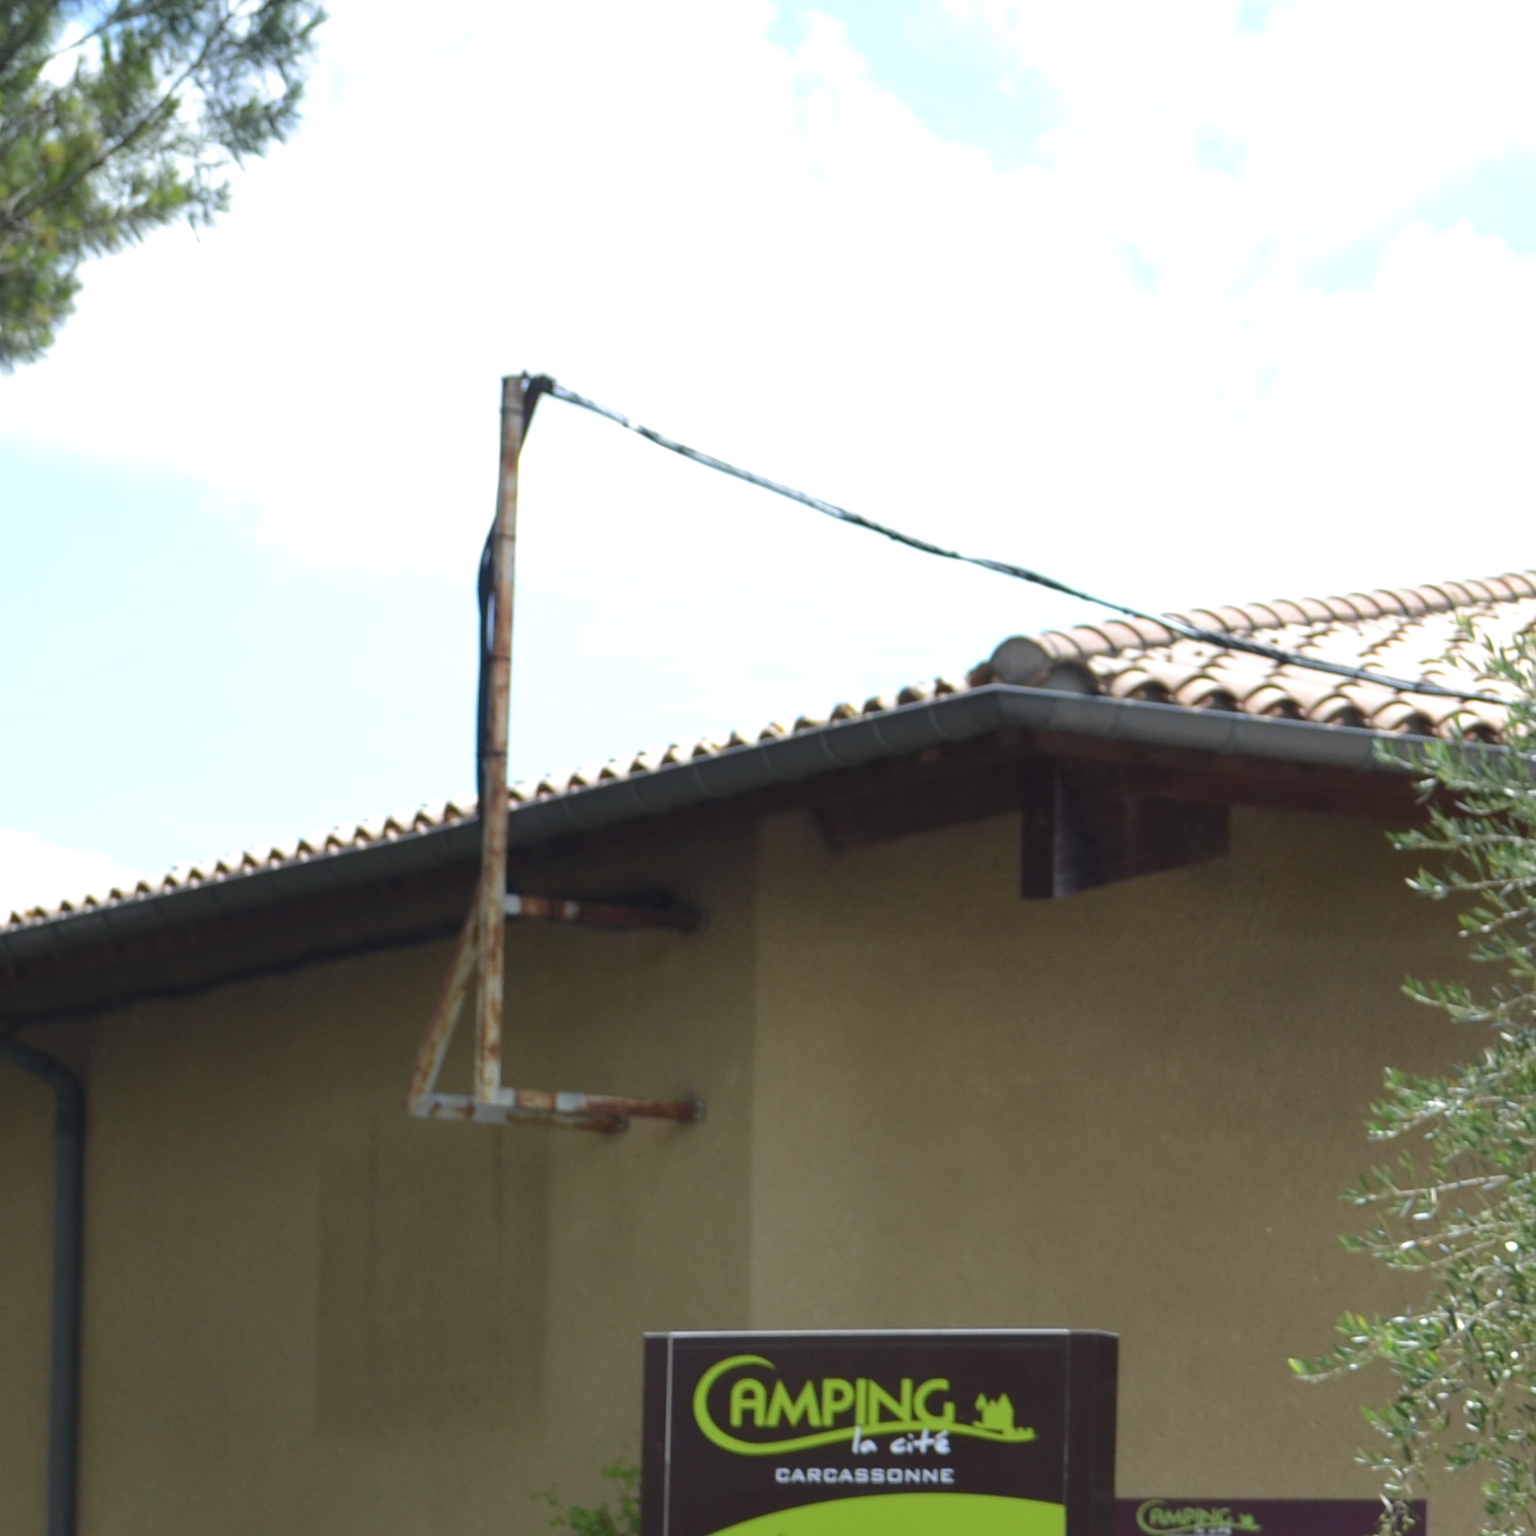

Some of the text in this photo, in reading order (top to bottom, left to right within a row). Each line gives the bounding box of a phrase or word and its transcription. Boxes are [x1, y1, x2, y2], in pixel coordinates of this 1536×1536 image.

[693, 1354, 956, 1456] CAMPING
[851, 1424, 952, 1455] la cité
[774, 1467, 955, 1485] CARCASSONNE
